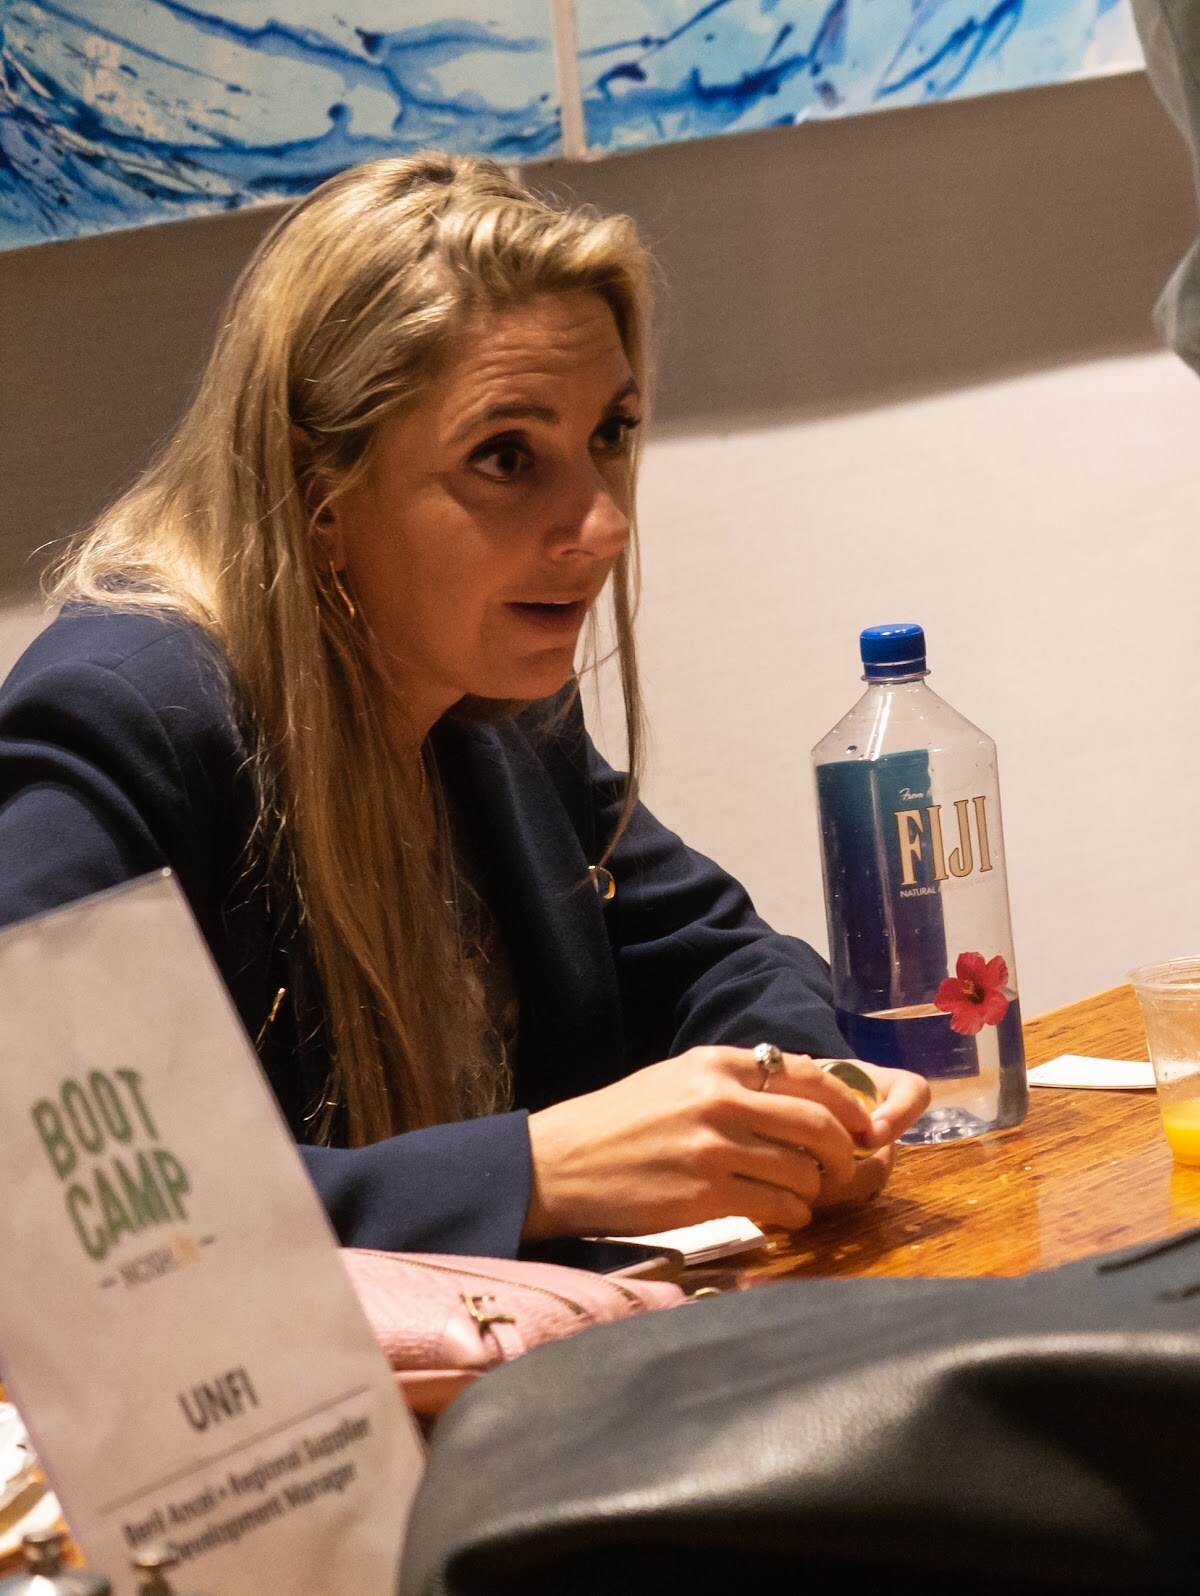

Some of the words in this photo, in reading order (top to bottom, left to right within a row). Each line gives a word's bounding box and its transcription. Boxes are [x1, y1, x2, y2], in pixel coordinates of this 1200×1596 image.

[898, 787, 925, 801] From
[893, 795, 993, 888] FIJI
[900, 885, 937, 898] NATURAL
[32, 1066, 160, 1181] BOOT
[64, 1148, 191, 1261] CAMP
[177, 1365, 260, 1433] UNFI
